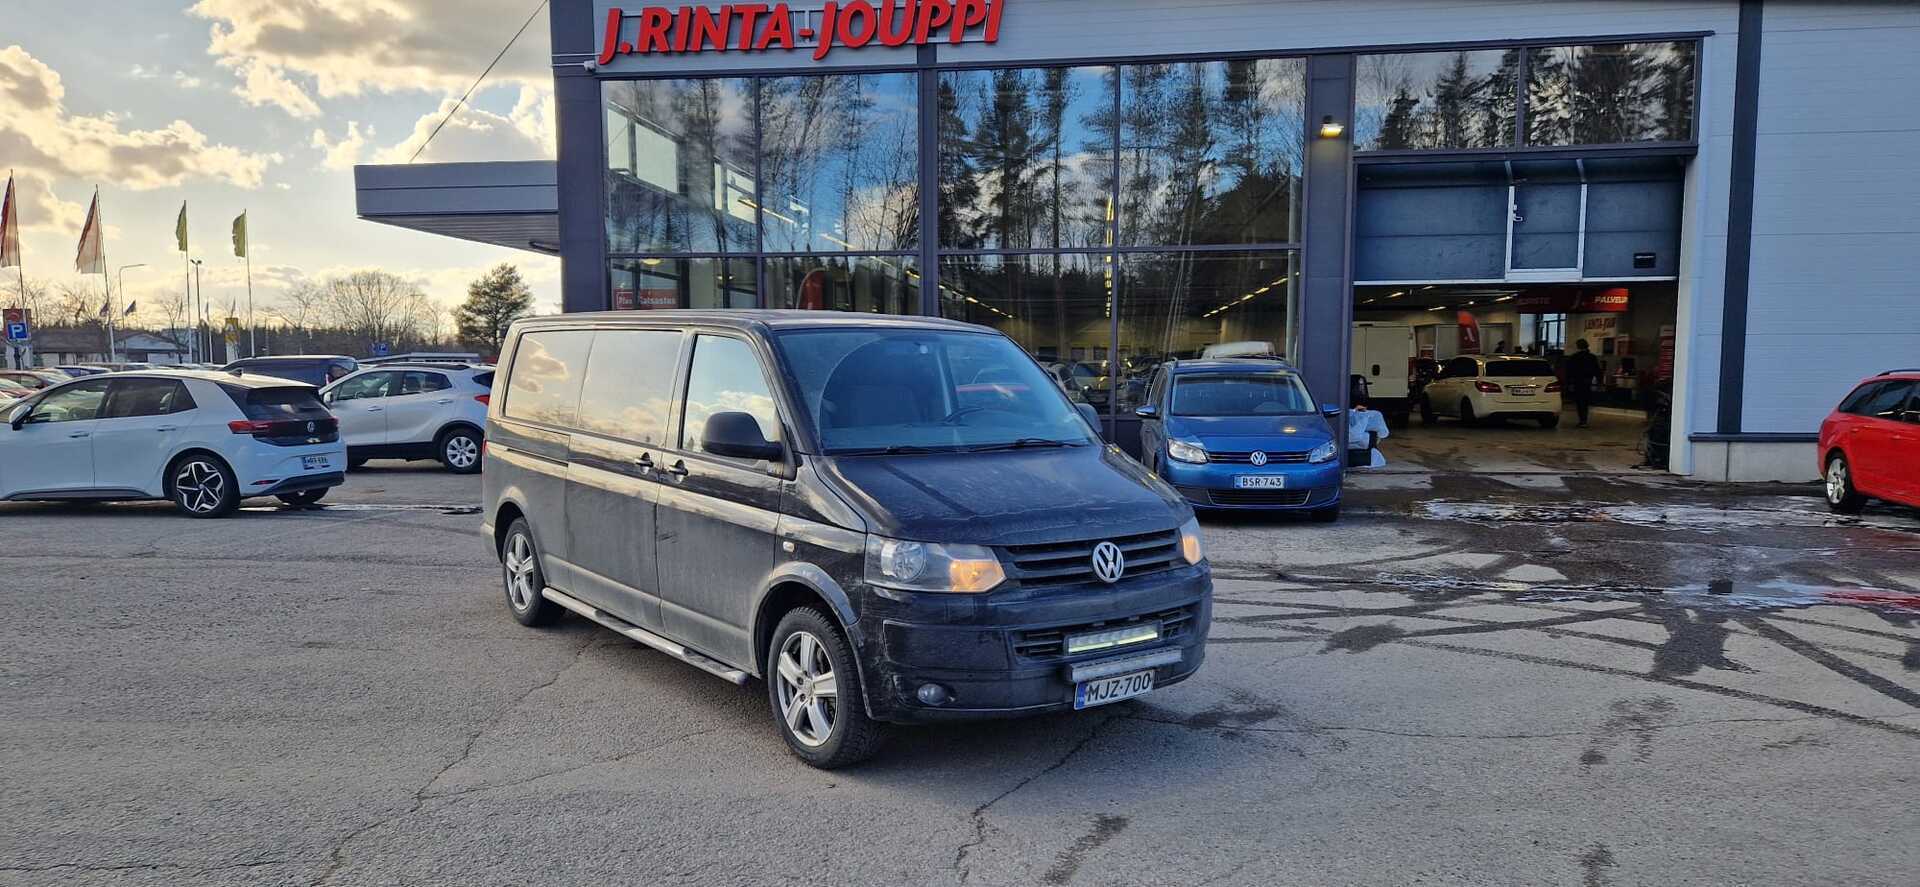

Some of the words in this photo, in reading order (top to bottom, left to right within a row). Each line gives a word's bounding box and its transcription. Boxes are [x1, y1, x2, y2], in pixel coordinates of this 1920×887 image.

[599, 0, 1004, 66] J.RINTA-JOUPPI
[11, 324, 24, 338] P
[1242, 477, 1282, 487] BSR-743
[1086, 672, 1152, 702] MJZ-700
